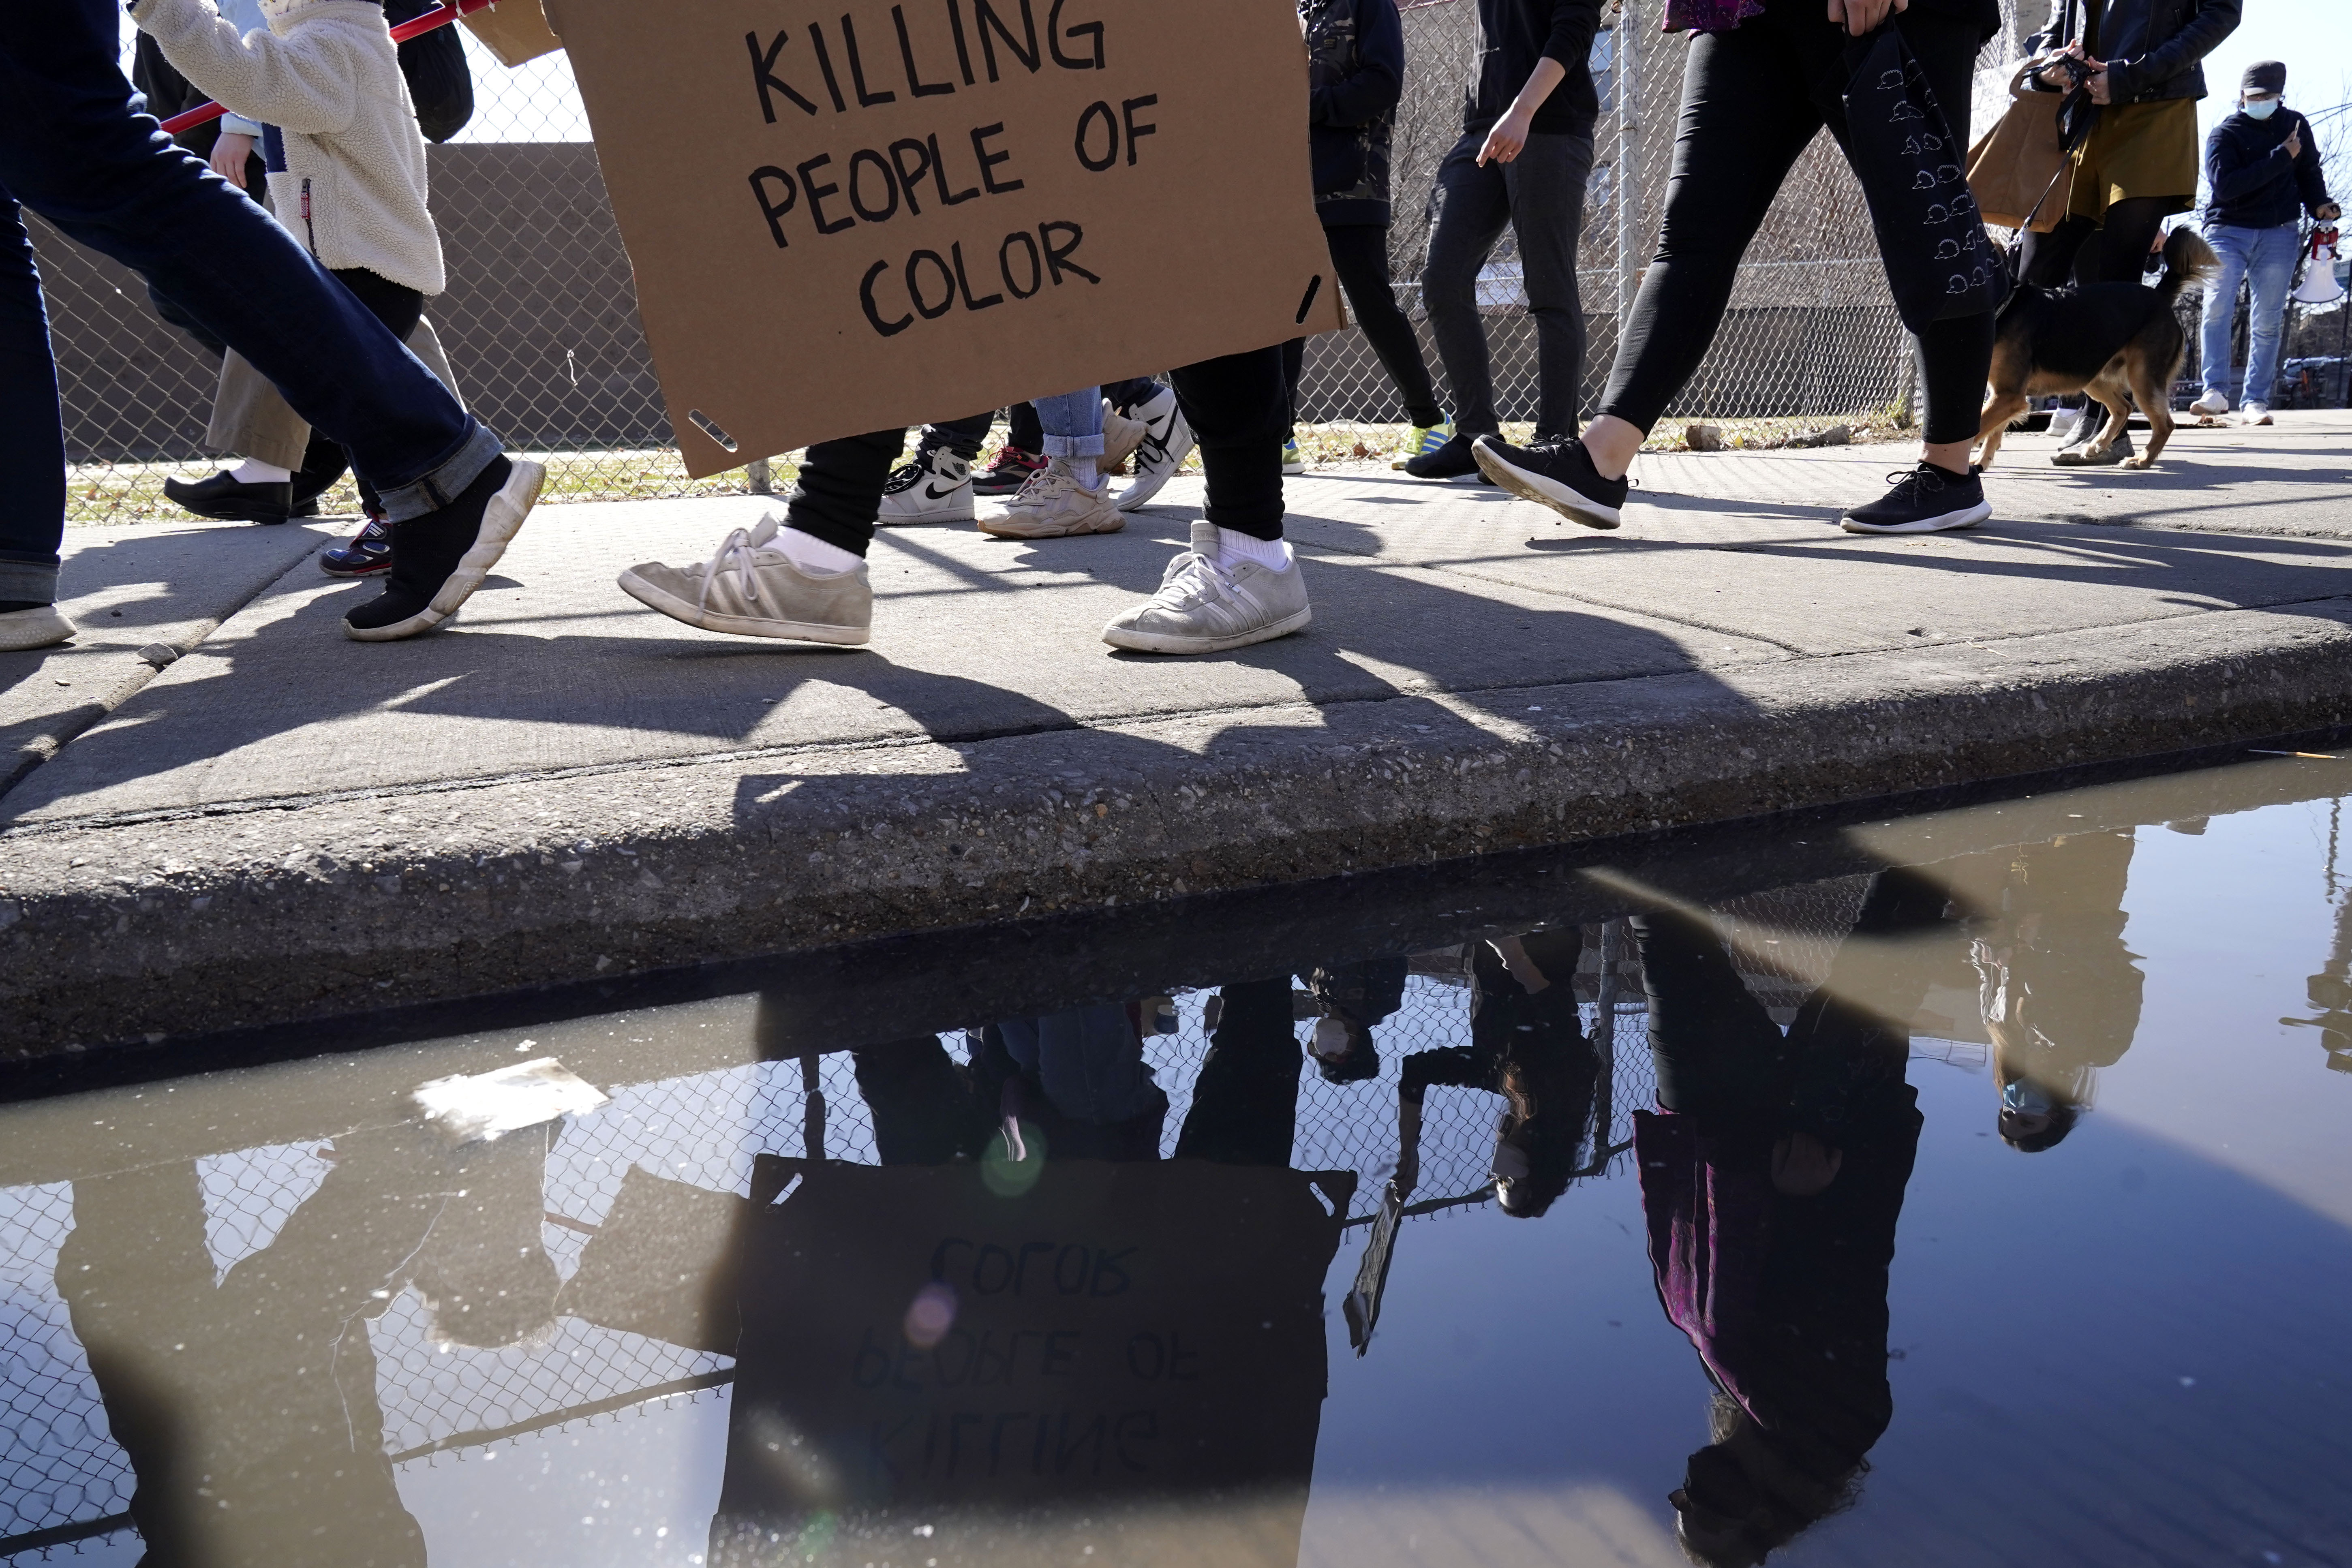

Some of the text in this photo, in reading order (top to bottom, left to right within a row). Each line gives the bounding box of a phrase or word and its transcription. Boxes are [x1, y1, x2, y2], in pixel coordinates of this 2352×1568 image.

[745, 0, 1106, 125] KILLING
[747, 92, 1158, 249] PEOPLE OF
[858, 220, 1102, 338] COLOR
